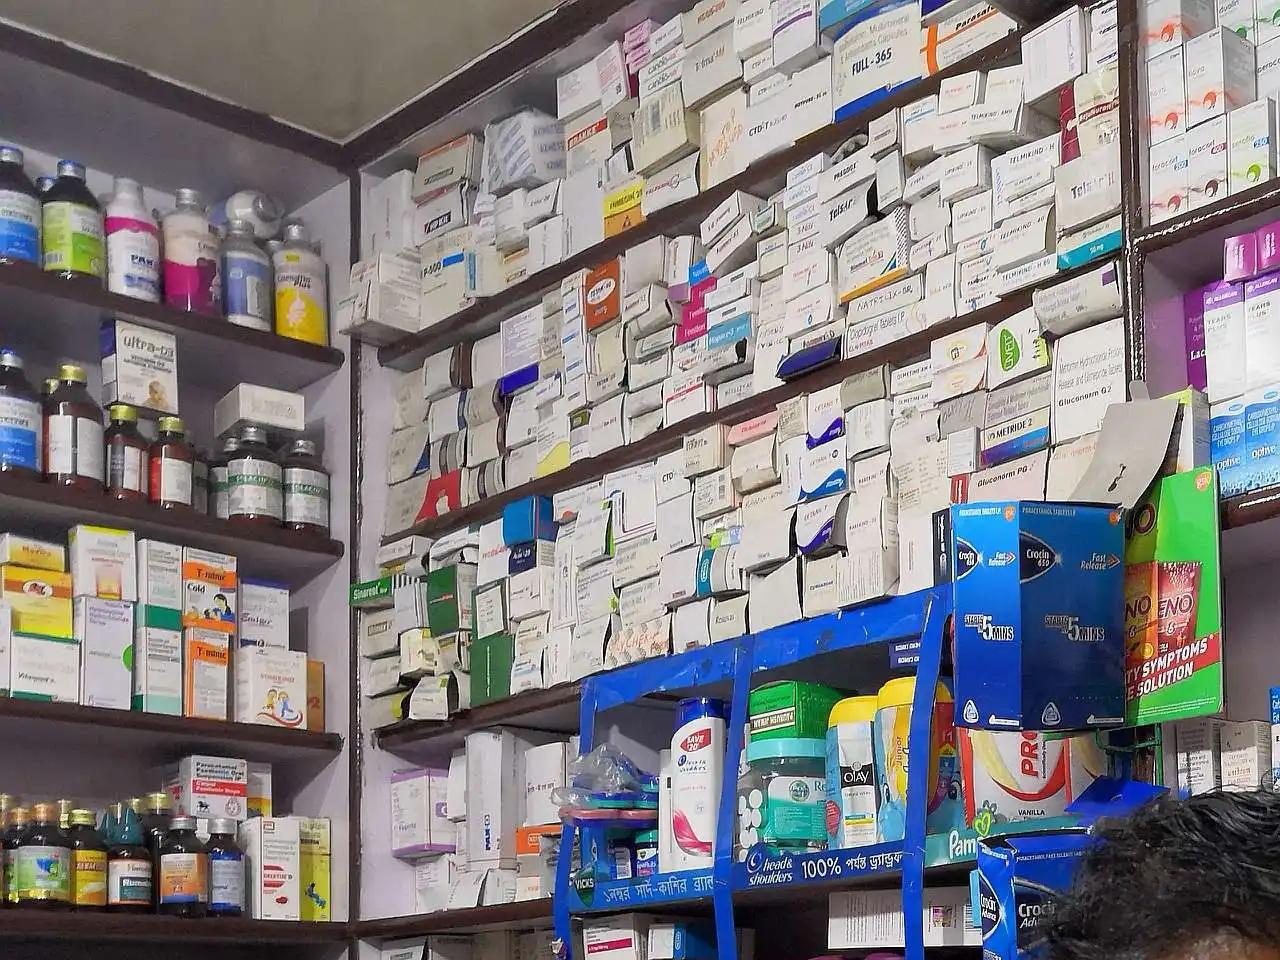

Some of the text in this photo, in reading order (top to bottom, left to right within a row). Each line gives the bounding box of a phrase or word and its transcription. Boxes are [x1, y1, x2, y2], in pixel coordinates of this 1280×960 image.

[995, 419, 1033, 439] METRIDE 2
[1026, 549, 1050, 560] Crocin
[187, 582, 205, 594] Cold
[1159, 592, 1195, 620] ENO
[1141, 638, 1208, 674] SYMPTOMS
[1138, 662, 1194, 695] SOLUTION
[844, 769, 869, 783] OLAY
[802, 857, 841, 878] 100%
[576, 878, 594, 889] VICKS
[749, 872, 793, 885] shoulders
